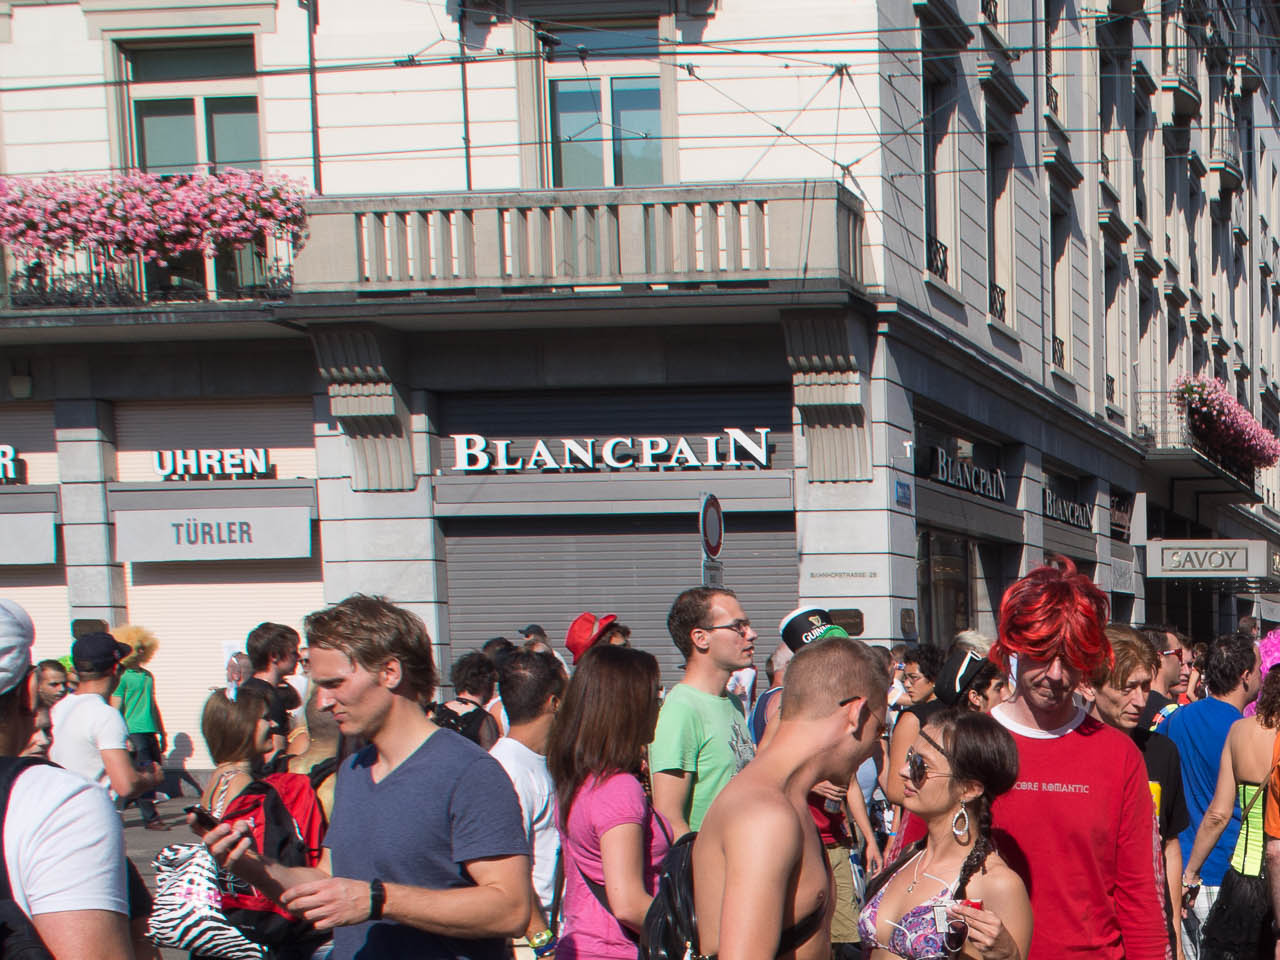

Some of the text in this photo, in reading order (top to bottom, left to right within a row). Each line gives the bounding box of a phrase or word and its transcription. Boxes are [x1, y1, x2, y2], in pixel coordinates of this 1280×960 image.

[152, 448, 266, 476] UHREN
[450, 427, 771, 471] BLANCPAIN
[937, 447, 1006, 499] BLANCPAIN
[1046, 487, 1092, 528] BLANCPAIN
[172, 517, 253, 545] TÜRLER
[1172, 551, 1236, 568] SAVOY
[1042, 782, 1089, 793] ROMANTIC
